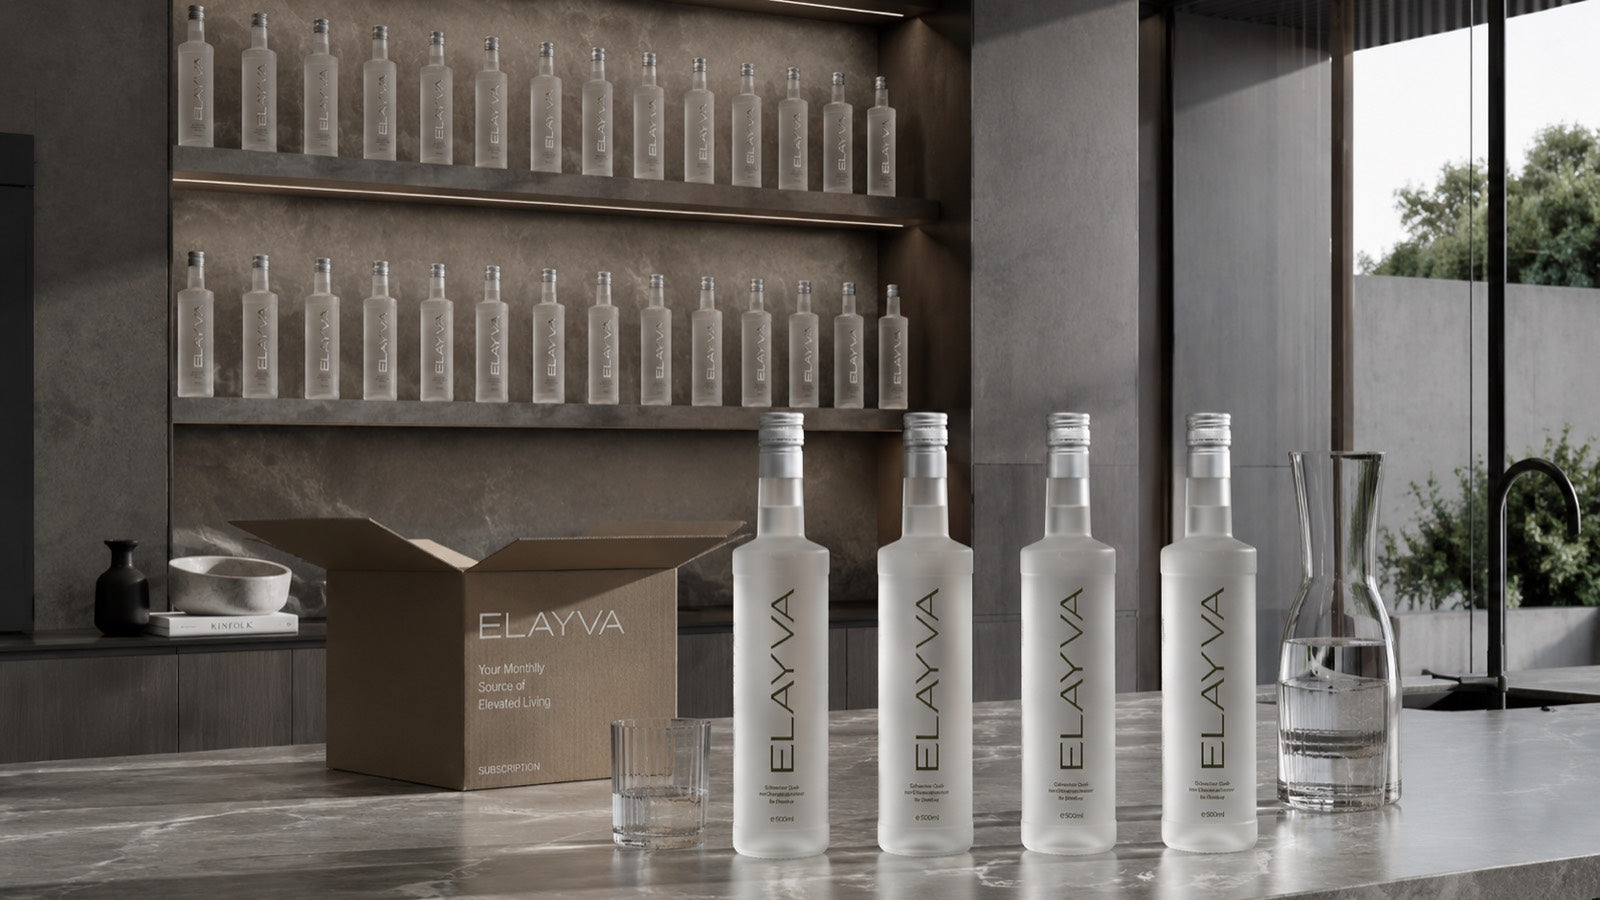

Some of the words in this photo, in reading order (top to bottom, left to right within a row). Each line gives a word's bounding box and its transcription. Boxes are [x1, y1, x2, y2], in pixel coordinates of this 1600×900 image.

[193, 58, 203, 121] ELAYVA
[257, 63, 267, 126] ELAYVA
[319, 69, 329, 131] ELAYVA
[378, 74, 388, 136] ELAYVA
[435, 78, 444, 140] ELAYVA
[490, 84, 500, 144] ELAYVA
[545, 88, 555, 149] ELAYVA
[596, 94, 606, 153] ELAYVA
[648, 98, 657, 157] ELAYVA
[699, 103, 707, 161] ELAYVA
[746, 106, 755, 165] ELAYVA
[793, 112, 802, 168] ELAYVA
[838, 115, 847, 170] ELAYVA
[881, 119, 890, 174] ELAYVA
[193, 304, 204, 368] ELAYVA
[257, 306, 269, 370] ELAYVA
[320, 309, 330, 372] ELAYVA
[378, 312, 388, 373] ELAYVA
[434, 313, 444, 375] ELAYVA
[490, 315, 500, 376] ELAYVA
[547, 318, 557, 377] ELAYVA
[602, 319, 612, 379] ELAYVA
[655, 320, 664, 379] ELAYVA
[706, 322, 715, 380] ELAYVA
[756, 325, 765, 381] ELAYVA
[804, 327, 813, 383] ELAYVA
[849, 328, 858, 384] ELAYVA
[893, 328, 901, 385] ELAYVA
[210, 622, 253, 630] KINFOLK
[479, 609, 625, 640] ELAYVA
[478, 664, 501, 675] Your
[478, 681, 513, 693] Source
[516, 679, 526, 691] of
[770, 588, 794, 773] ELAYVA
[915, 588, 939, 771] ELAYVA
[1060, 587, 1083, 769] ELAYVA
[1201, 587, 1224, 769] ELAYVA
[478, 697, 521, 710] Elevated
[523, 695, 551, 709] Living
[478, 762, 541, 775] SUBSCRIPTION
